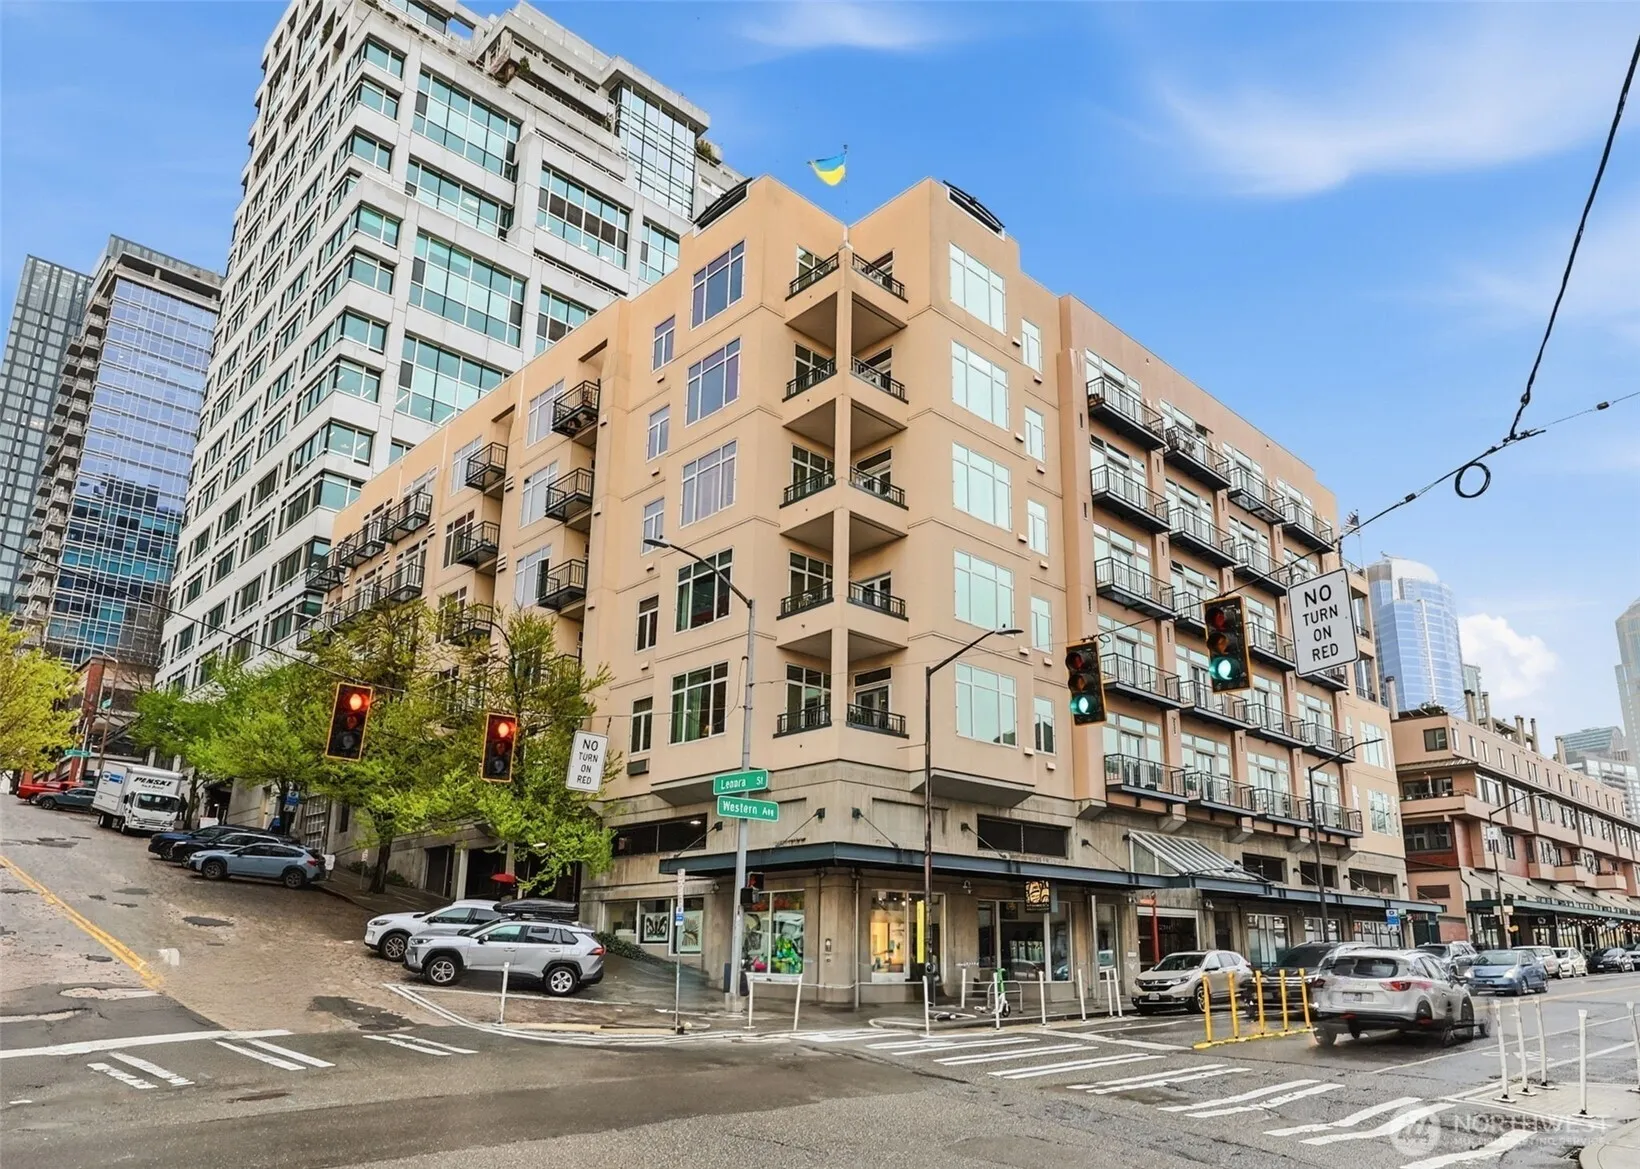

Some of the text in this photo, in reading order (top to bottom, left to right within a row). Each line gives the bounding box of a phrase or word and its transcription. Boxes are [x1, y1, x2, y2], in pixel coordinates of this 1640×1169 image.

[1304, 584, 1332, 608] NO
[1302, 604, 1338, 626] TURN
[1313, 625, 1332, 642] ON
[1312, 643, 1339, 661] RED
[582, 739, 599, 751] NO
[579, 752, 599, 763] TURN
[580, 764, 592, 773] ON
[134, 777, 171, 786] PENSKE
[577, 775, 592, 785] RED
[720, 776, 764, 790] Lenora St
[722, 800, 774, 817] Western Ave
